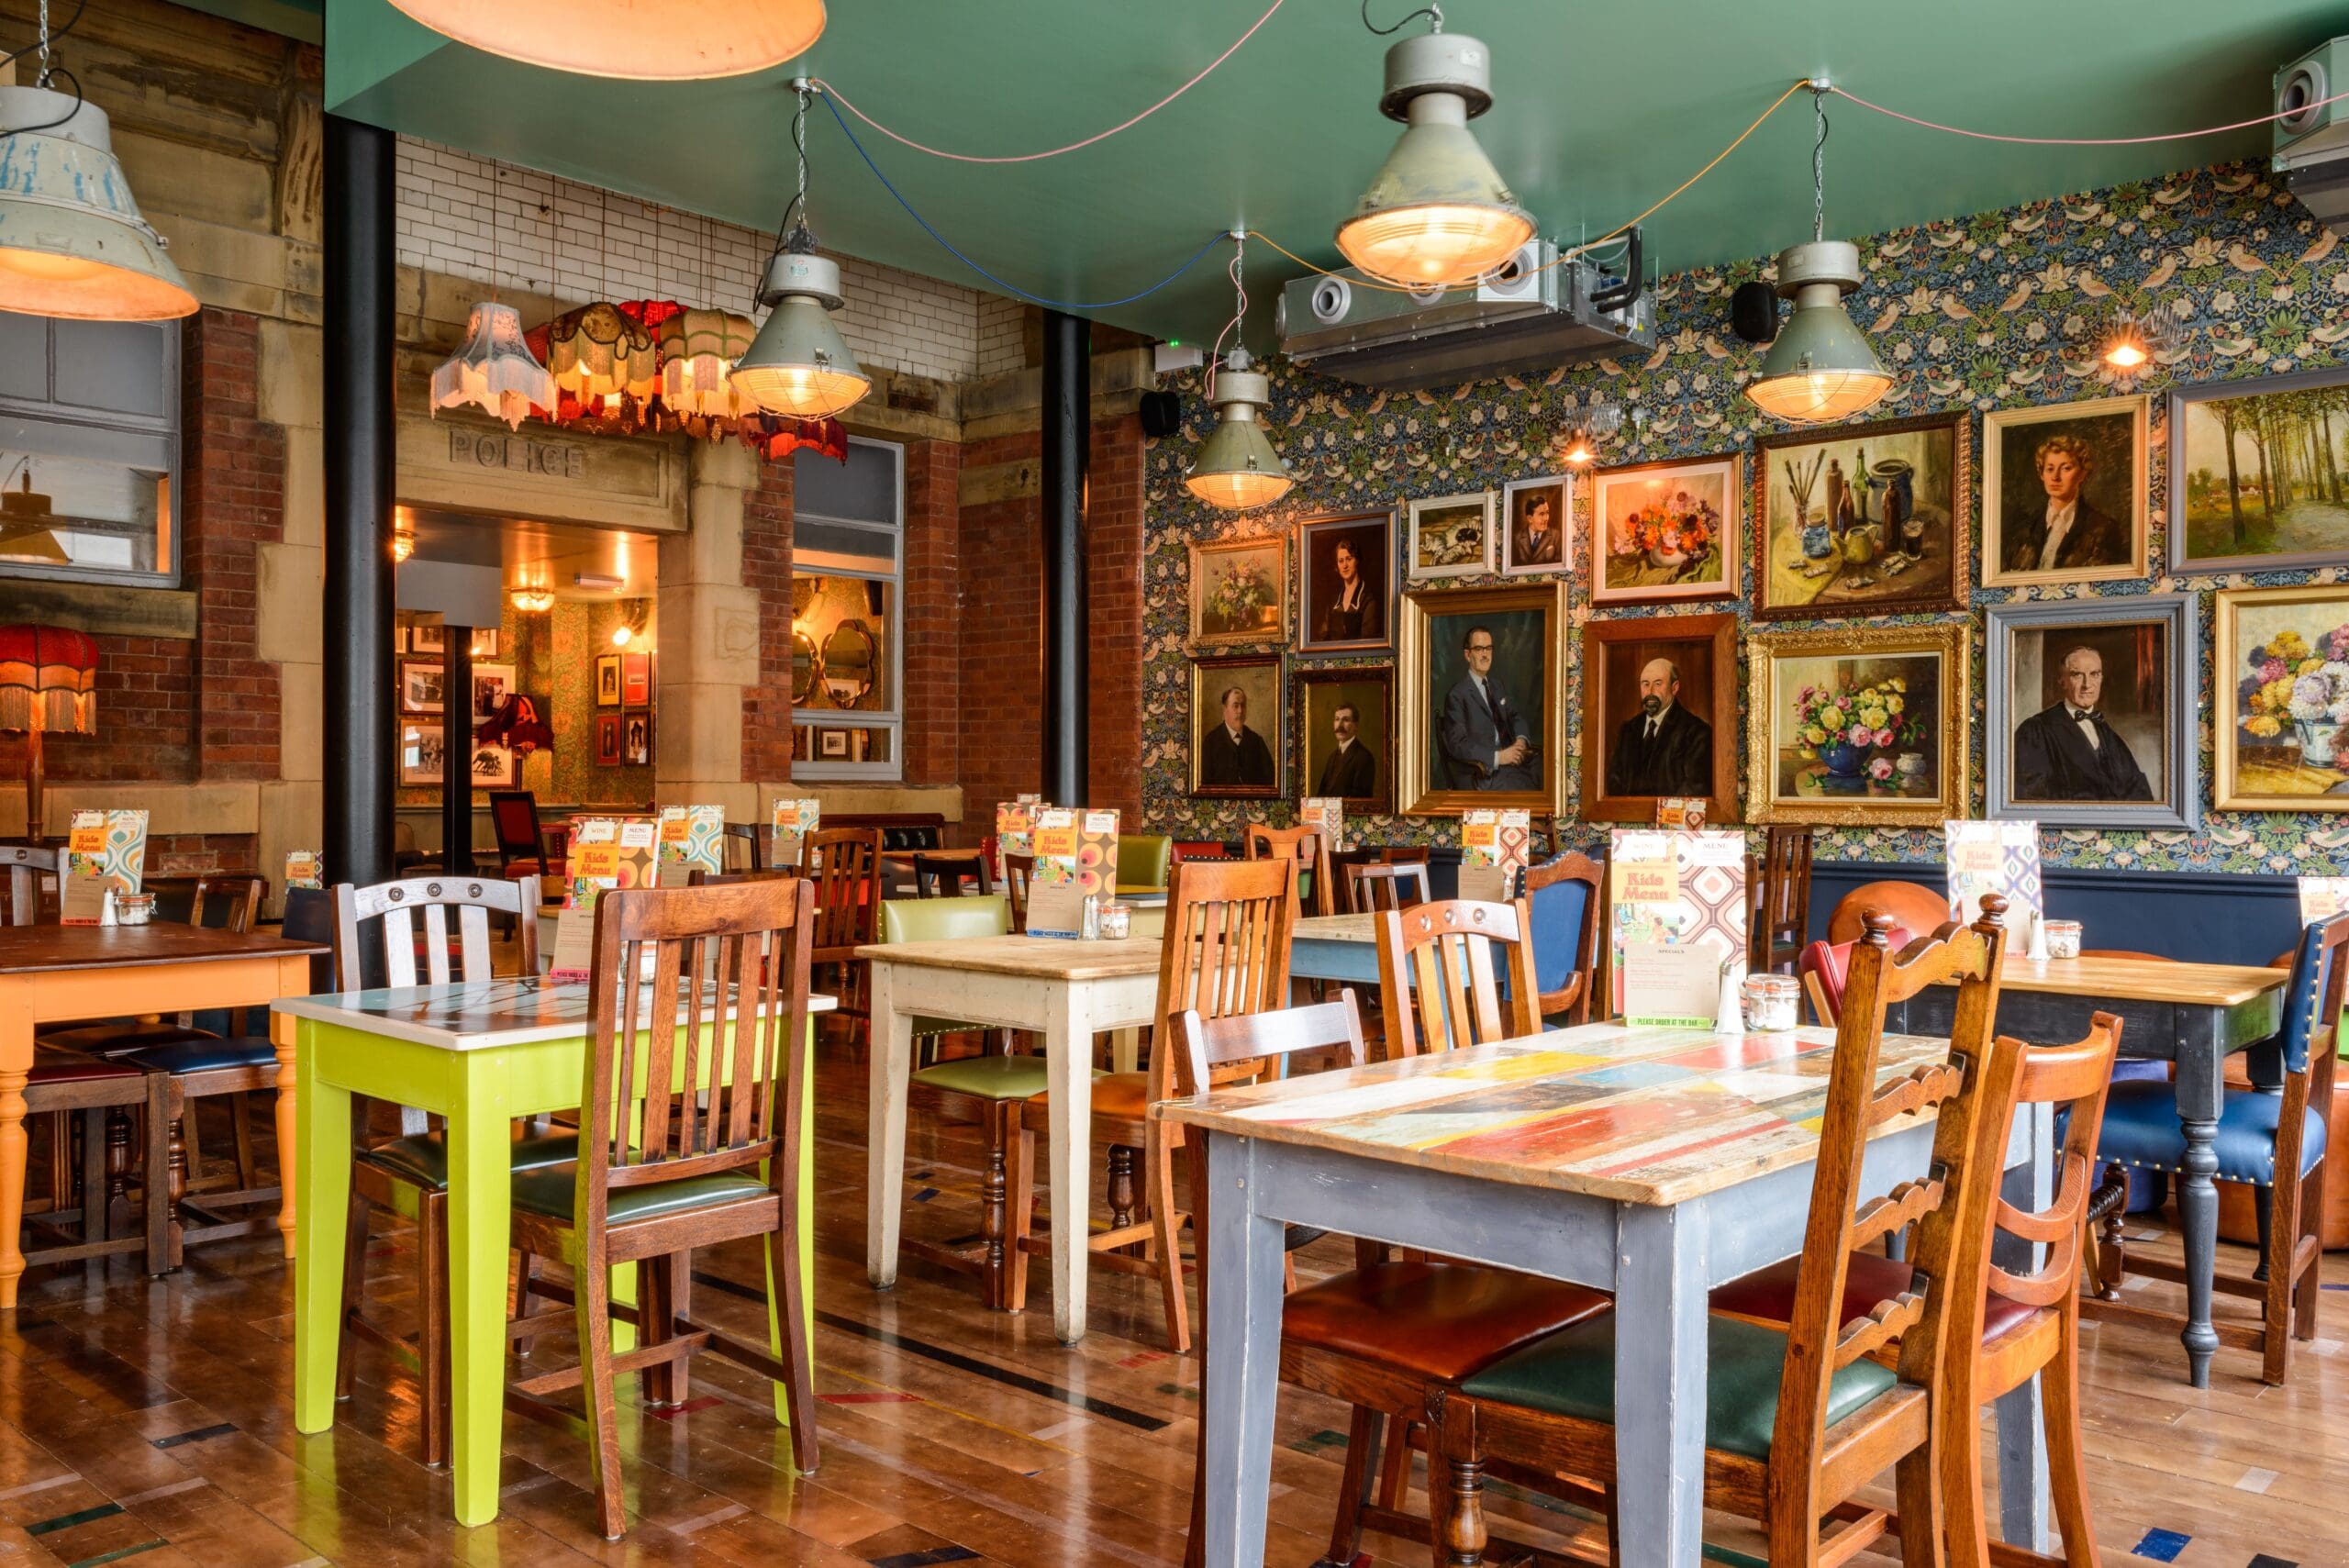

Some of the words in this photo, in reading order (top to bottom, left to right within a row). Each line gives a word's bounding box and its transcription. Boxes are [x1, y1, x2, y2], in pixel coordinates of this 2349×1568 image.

[450, 430, 584, 479] POLICE
[78, 835, 99, 843] Kids
[1043, 836, 1067, 845] Kids
[74, 843, 101, 851] Menu
[1040, 845, 1070, 854] Menu
[584, 851, 609, 863] Kids
[580, 863, 611, 875] Menu
[1627, 873, 1664, 886] Kids
[1622, 886, 1669, 901] Menu
